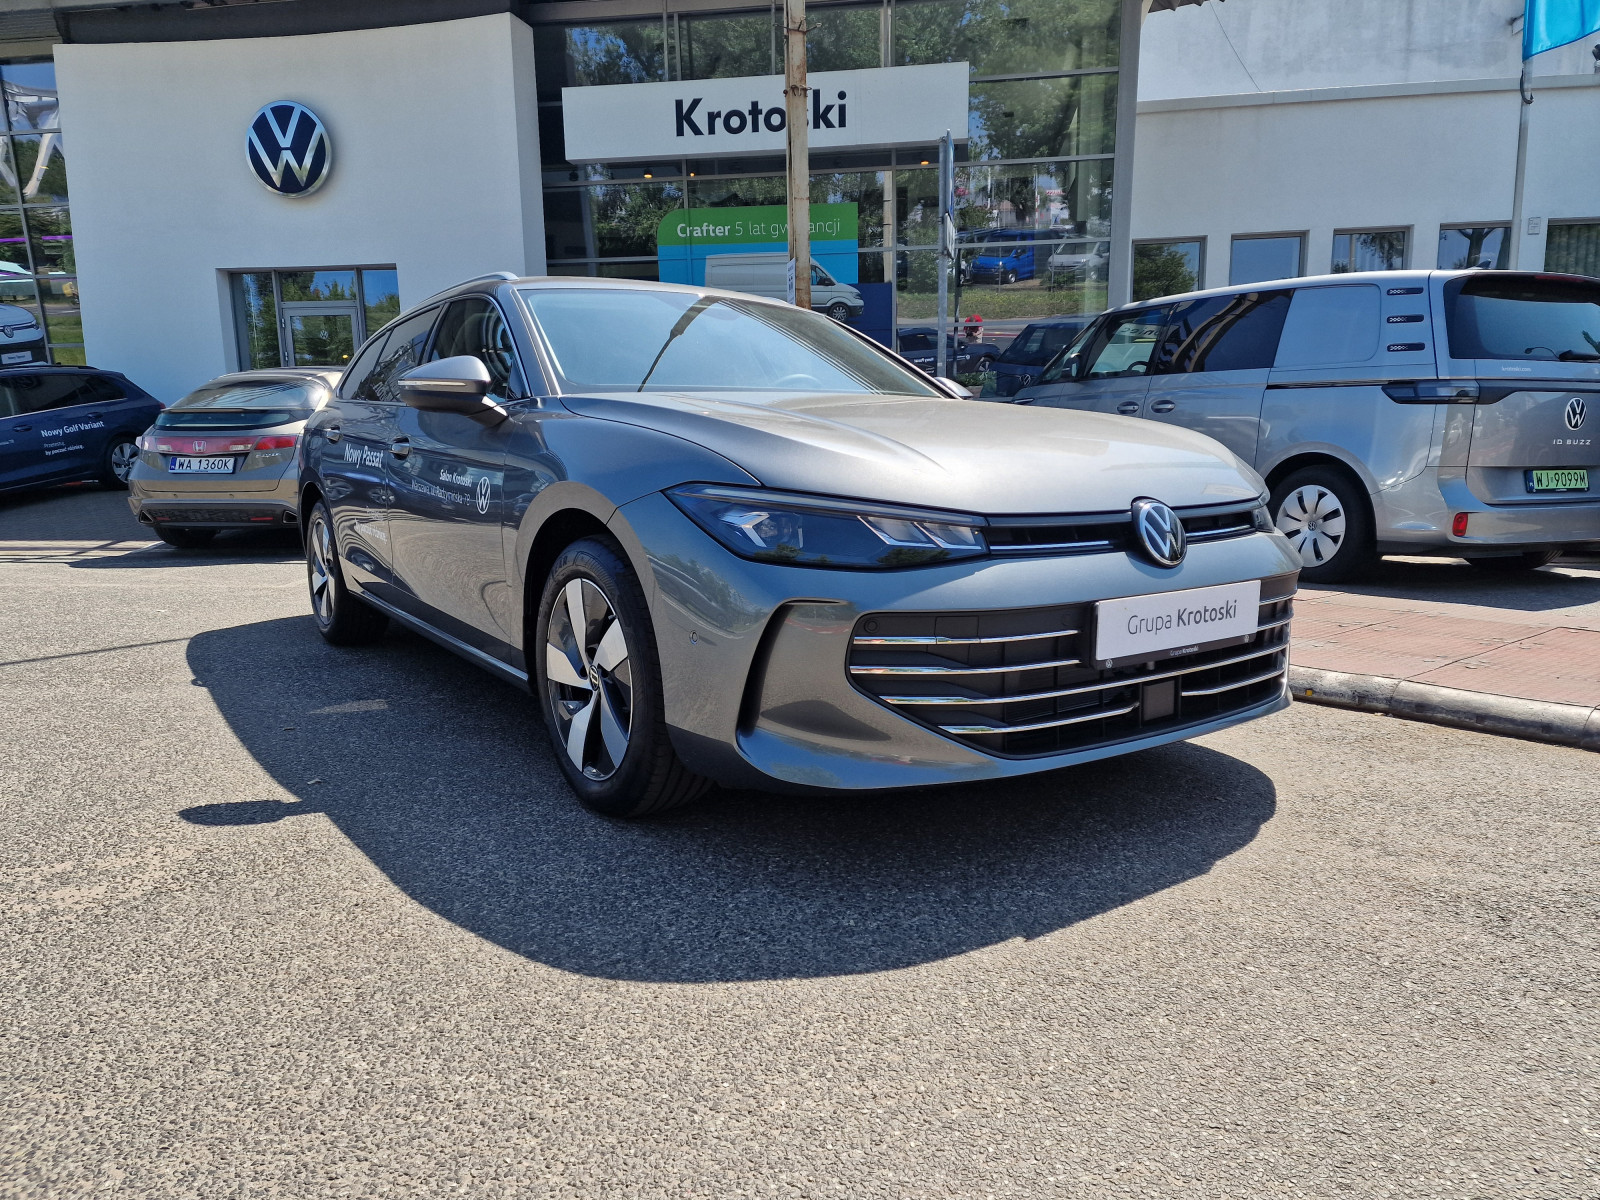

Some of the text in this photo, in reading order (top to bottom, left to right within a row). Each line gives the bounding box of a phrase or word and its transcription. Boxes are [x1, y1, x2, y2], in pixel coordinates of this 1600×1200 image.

[675, 89, 847, 137] Krotoki
[677, 219, 840, 238] Crafter 5 lat gwancji
[41, 421, 105, 438] Nowy Golf Variant
[178, 458, 231, 470] WA 1360K
[344, 443, 384, 468] Nowy Passat
[439, 468, 473, 488] Salon Krotoski
[1535, 471, 1586, 488] WJ 9099M
[1127, 599, 1237, 635] Grupa Krotoski
